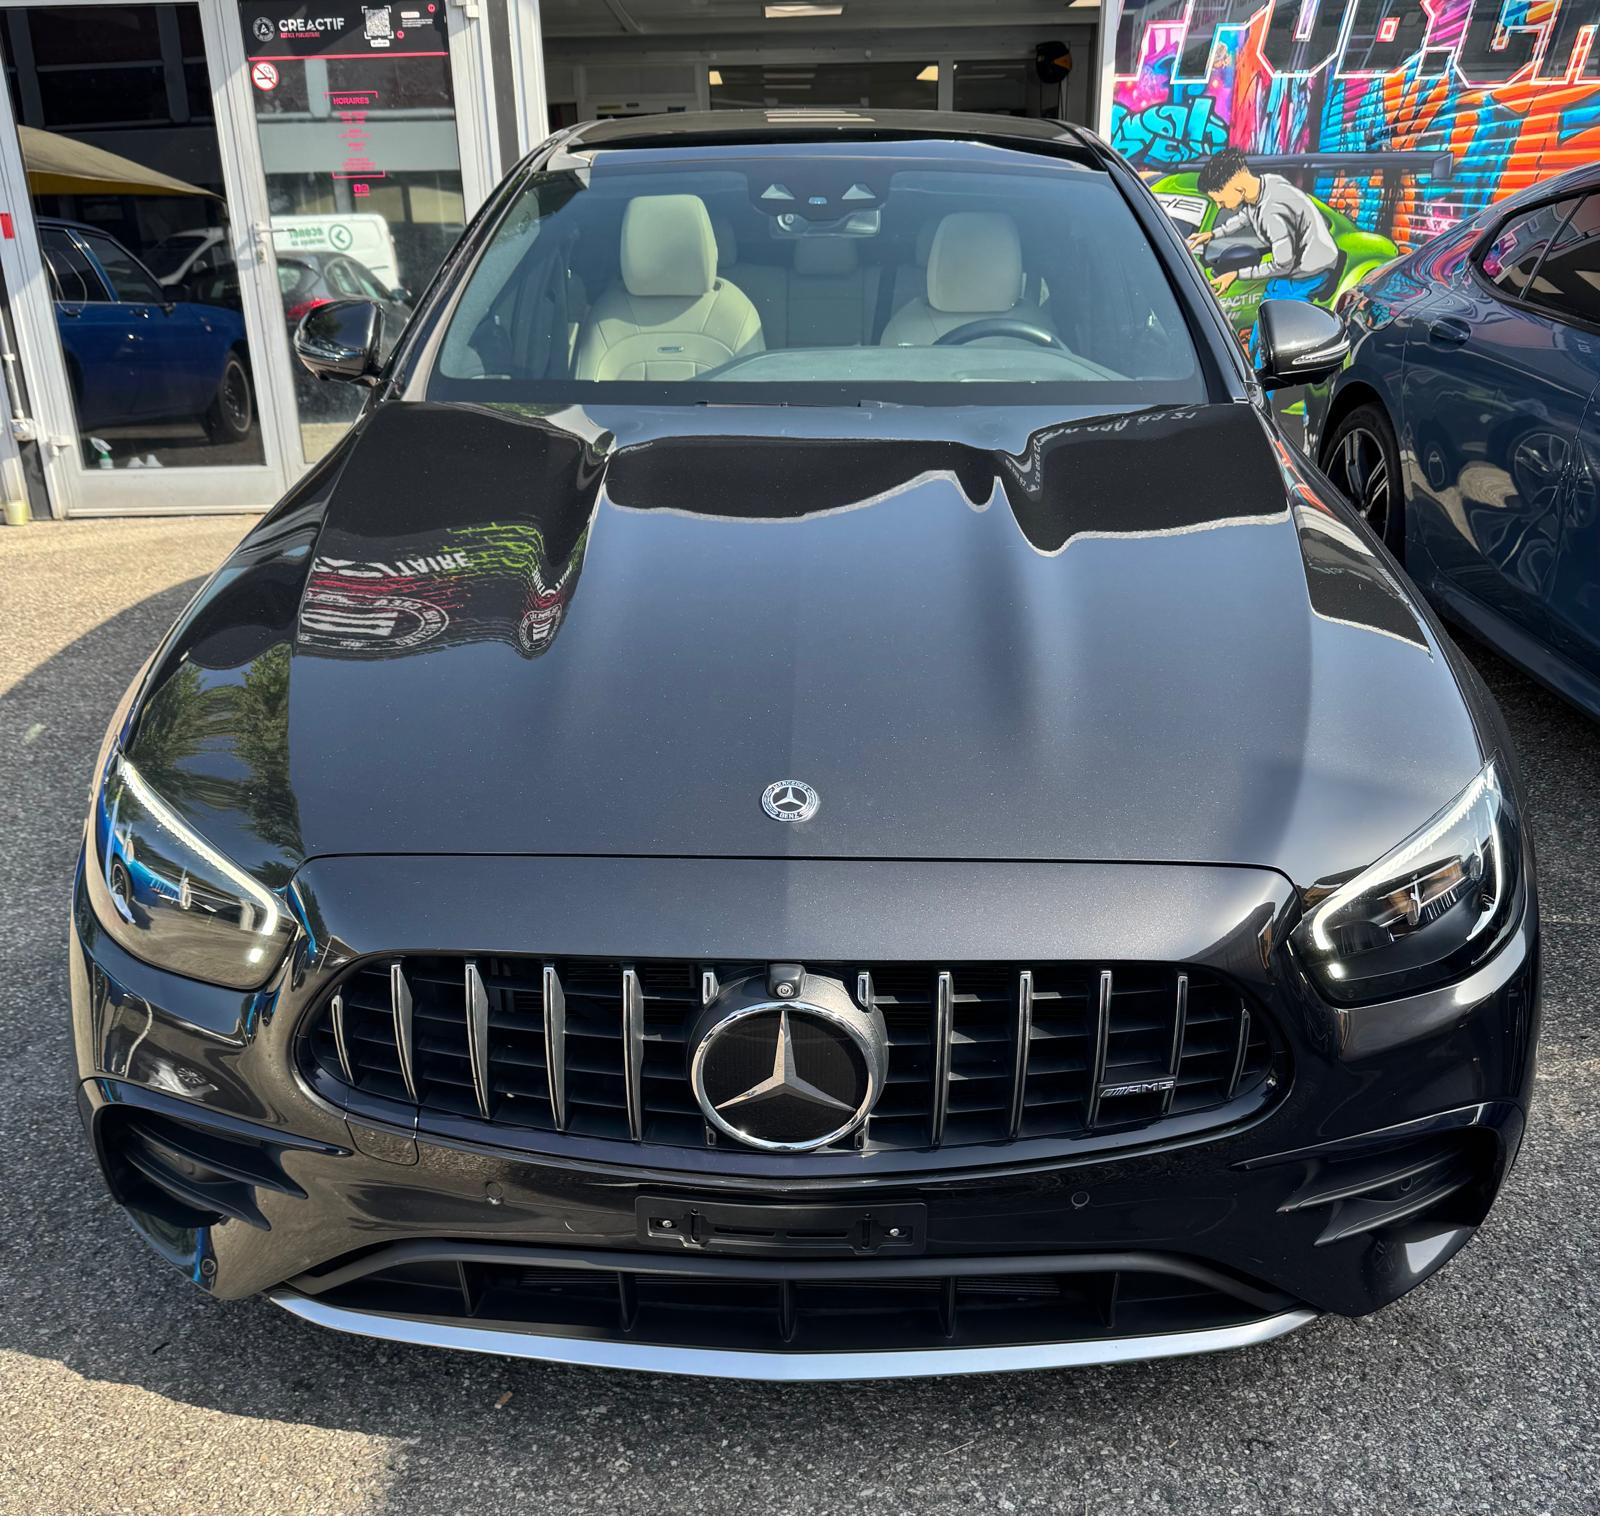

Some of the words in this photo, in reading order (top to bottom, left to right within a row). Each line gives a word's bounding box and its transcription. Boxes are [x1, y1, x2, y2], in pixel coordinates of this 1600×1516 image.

[278, 17, 345, 32] CREACTIF
[333, 97, 369, 105] HORAIRES
[1122, 1080, 1174, 1095] AMG
